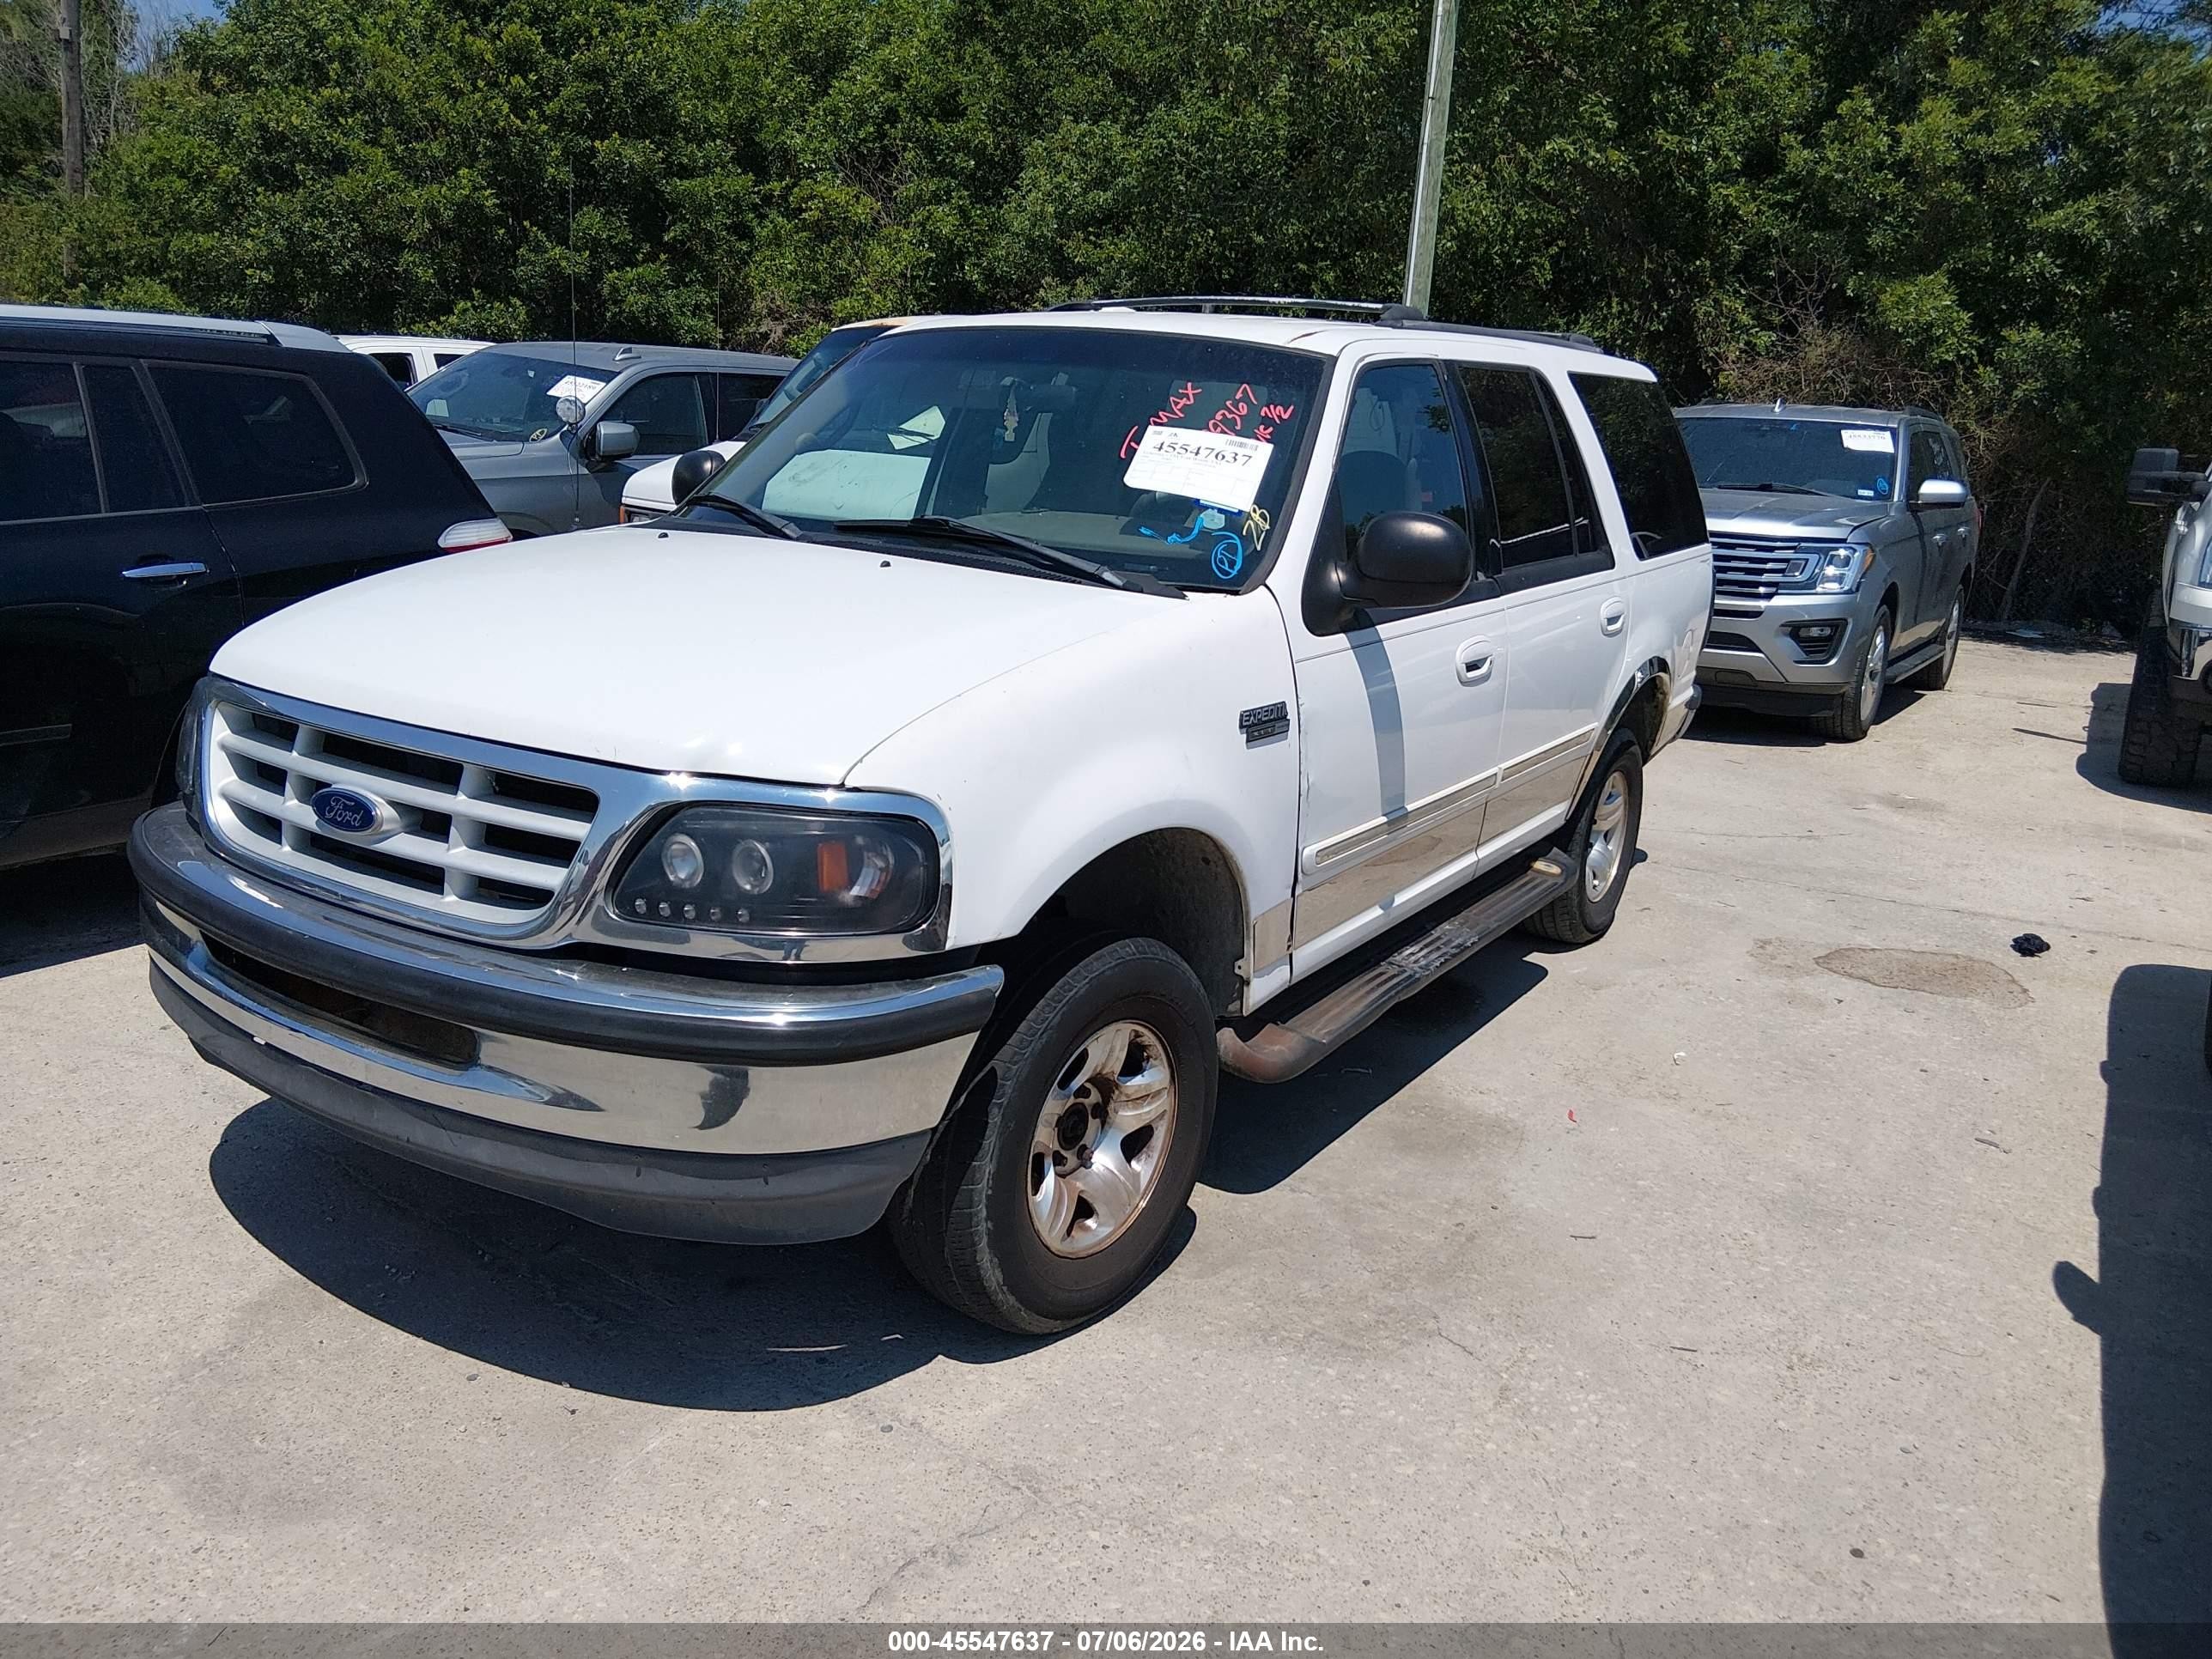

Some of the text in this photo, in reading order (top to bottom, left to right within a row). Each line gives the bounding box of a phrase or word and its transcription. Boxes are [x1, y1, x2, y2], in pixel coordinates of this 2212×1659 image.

[1149, 381, 1203, 426] MAX
[1201, 383, 1258, 436] 9367
[1152, 440, 1253, 467] 45547637
[1243, 703, 1288, 726] EXPEDITI
[325, 795, 364, 827] Ford
